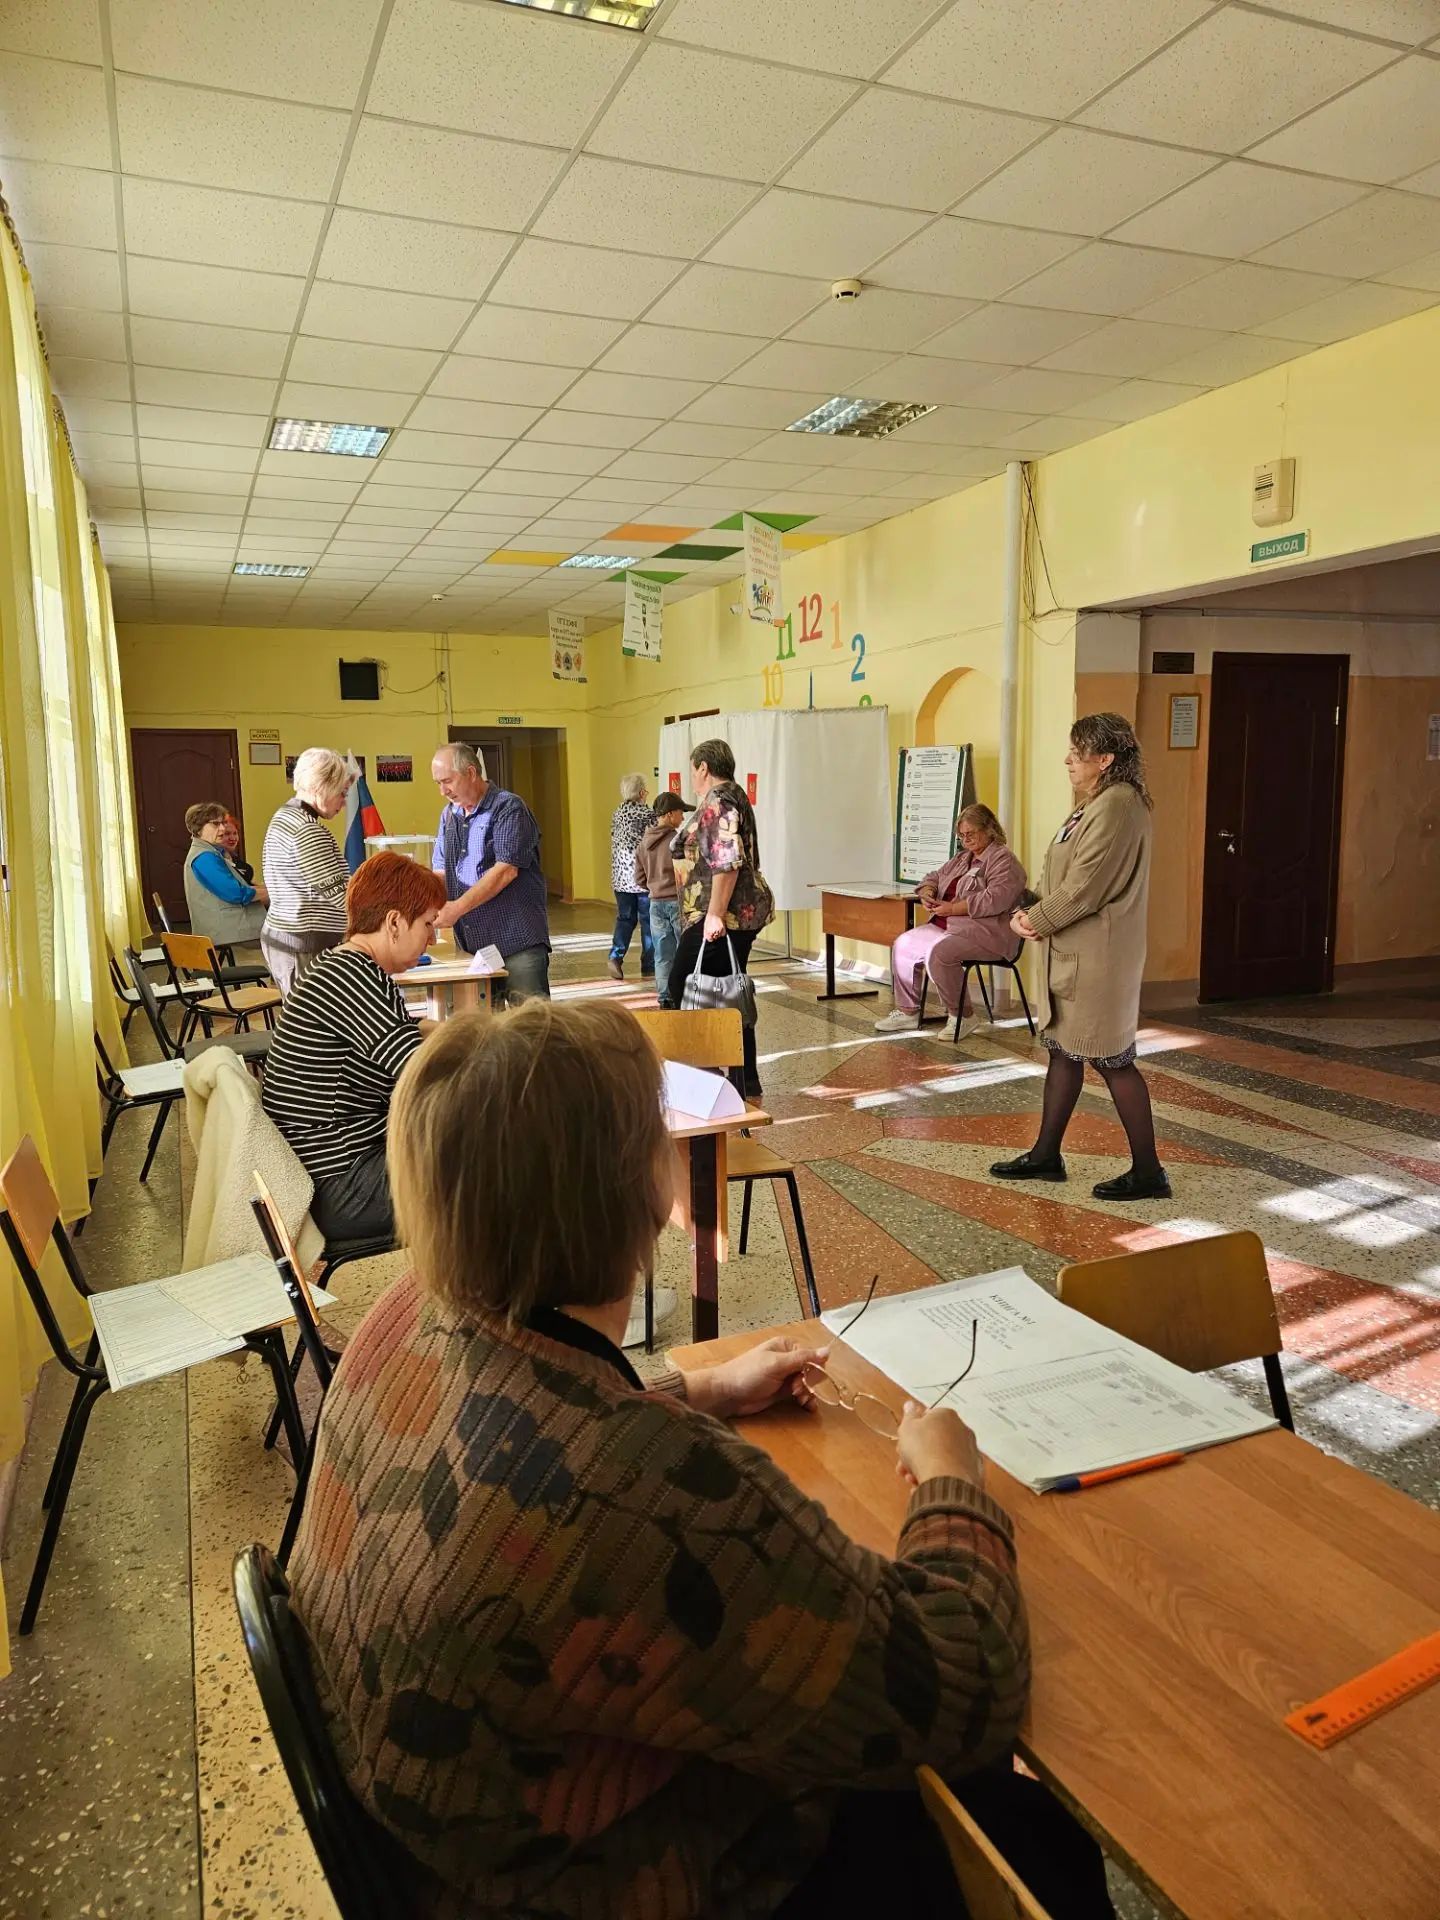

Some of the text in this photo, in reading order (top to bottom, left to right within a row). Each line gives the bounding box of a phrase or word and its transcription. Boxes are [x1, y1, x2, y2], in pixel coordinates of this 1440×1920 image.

[1258, 539, 1299, 557] ВЫХОД
[776, 612, 796, 661] 11
[798, 593, 823, 643] 12
[830, 600, 844, 650] 1
[851, 633, 866, 682] 2
[761, 663, 784, 707] 10
